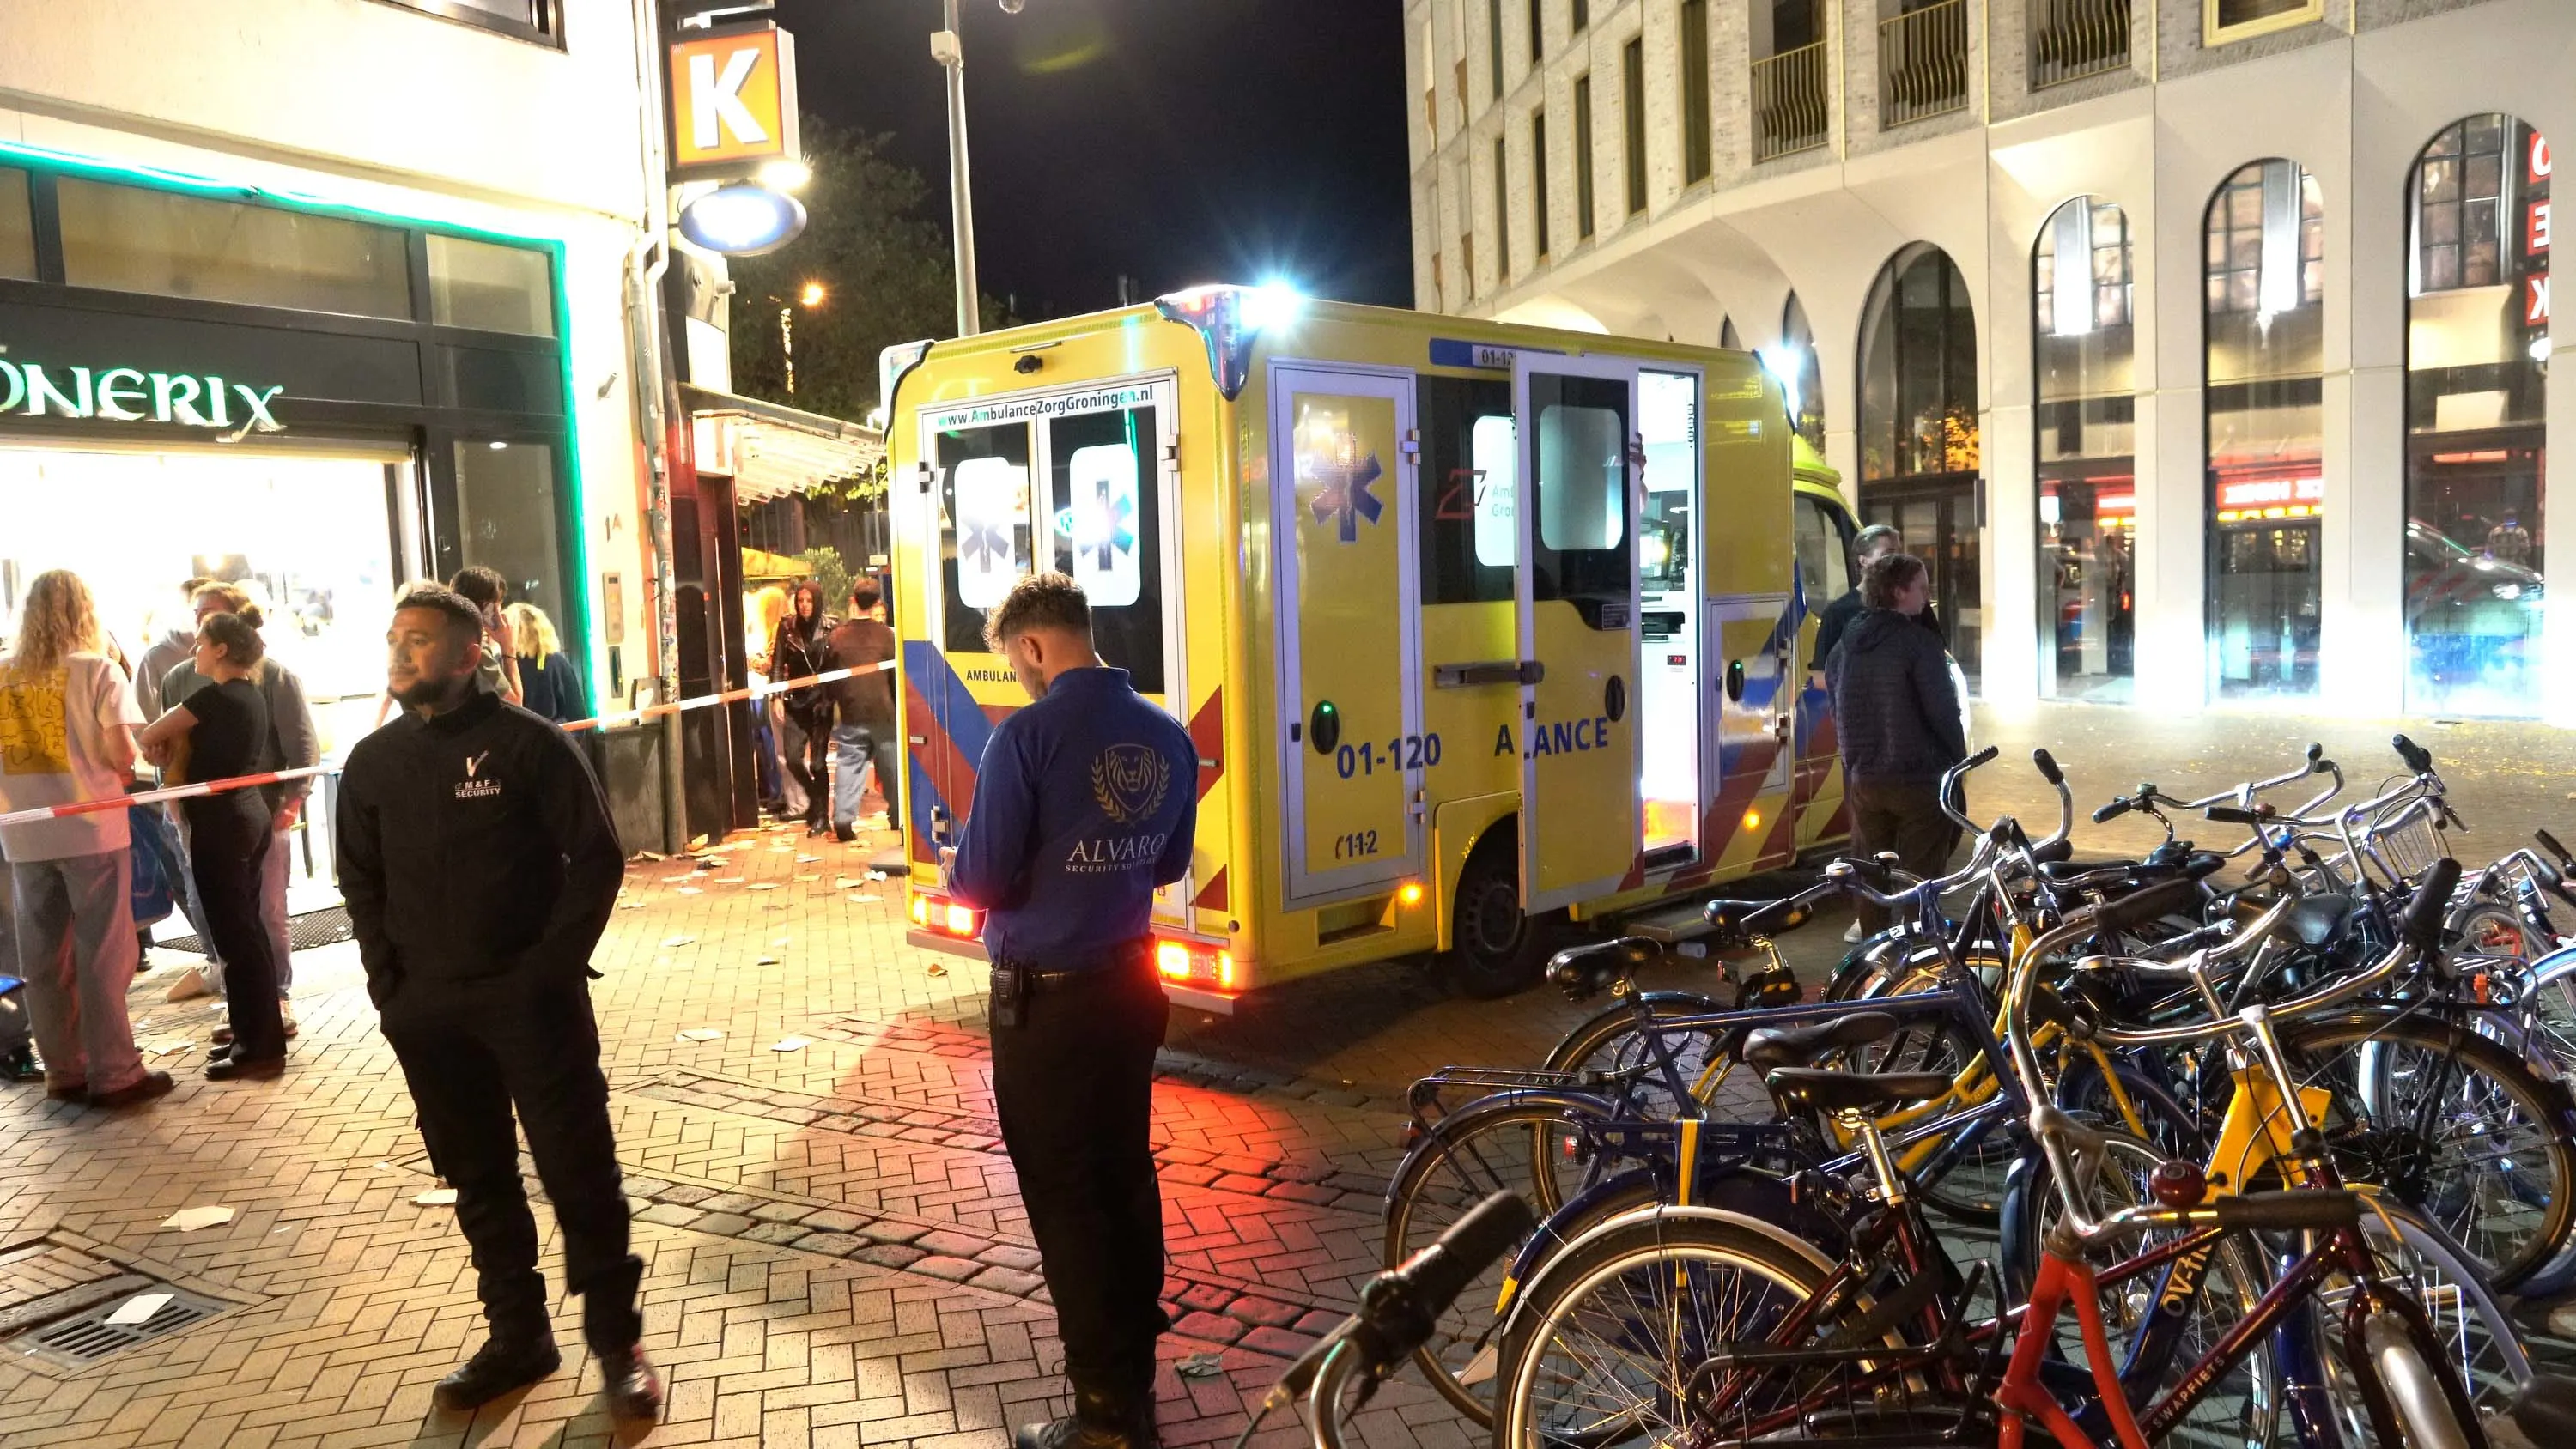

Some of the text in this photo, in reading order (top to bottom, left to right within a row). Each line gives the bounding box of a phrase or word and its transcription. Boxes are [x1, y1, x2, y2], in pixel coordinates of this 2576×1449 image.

[689, 48, 769, 149] K
[1337, 733, 1441, 779] 01-120
[455, 788, 501, 798] SECURITY
[1066, 833, 1165, 863] ALVARO
[1065, 864, 1119, 873] SECURITY
[2153, 1355, 2225, 1429] SWAPFIETS
